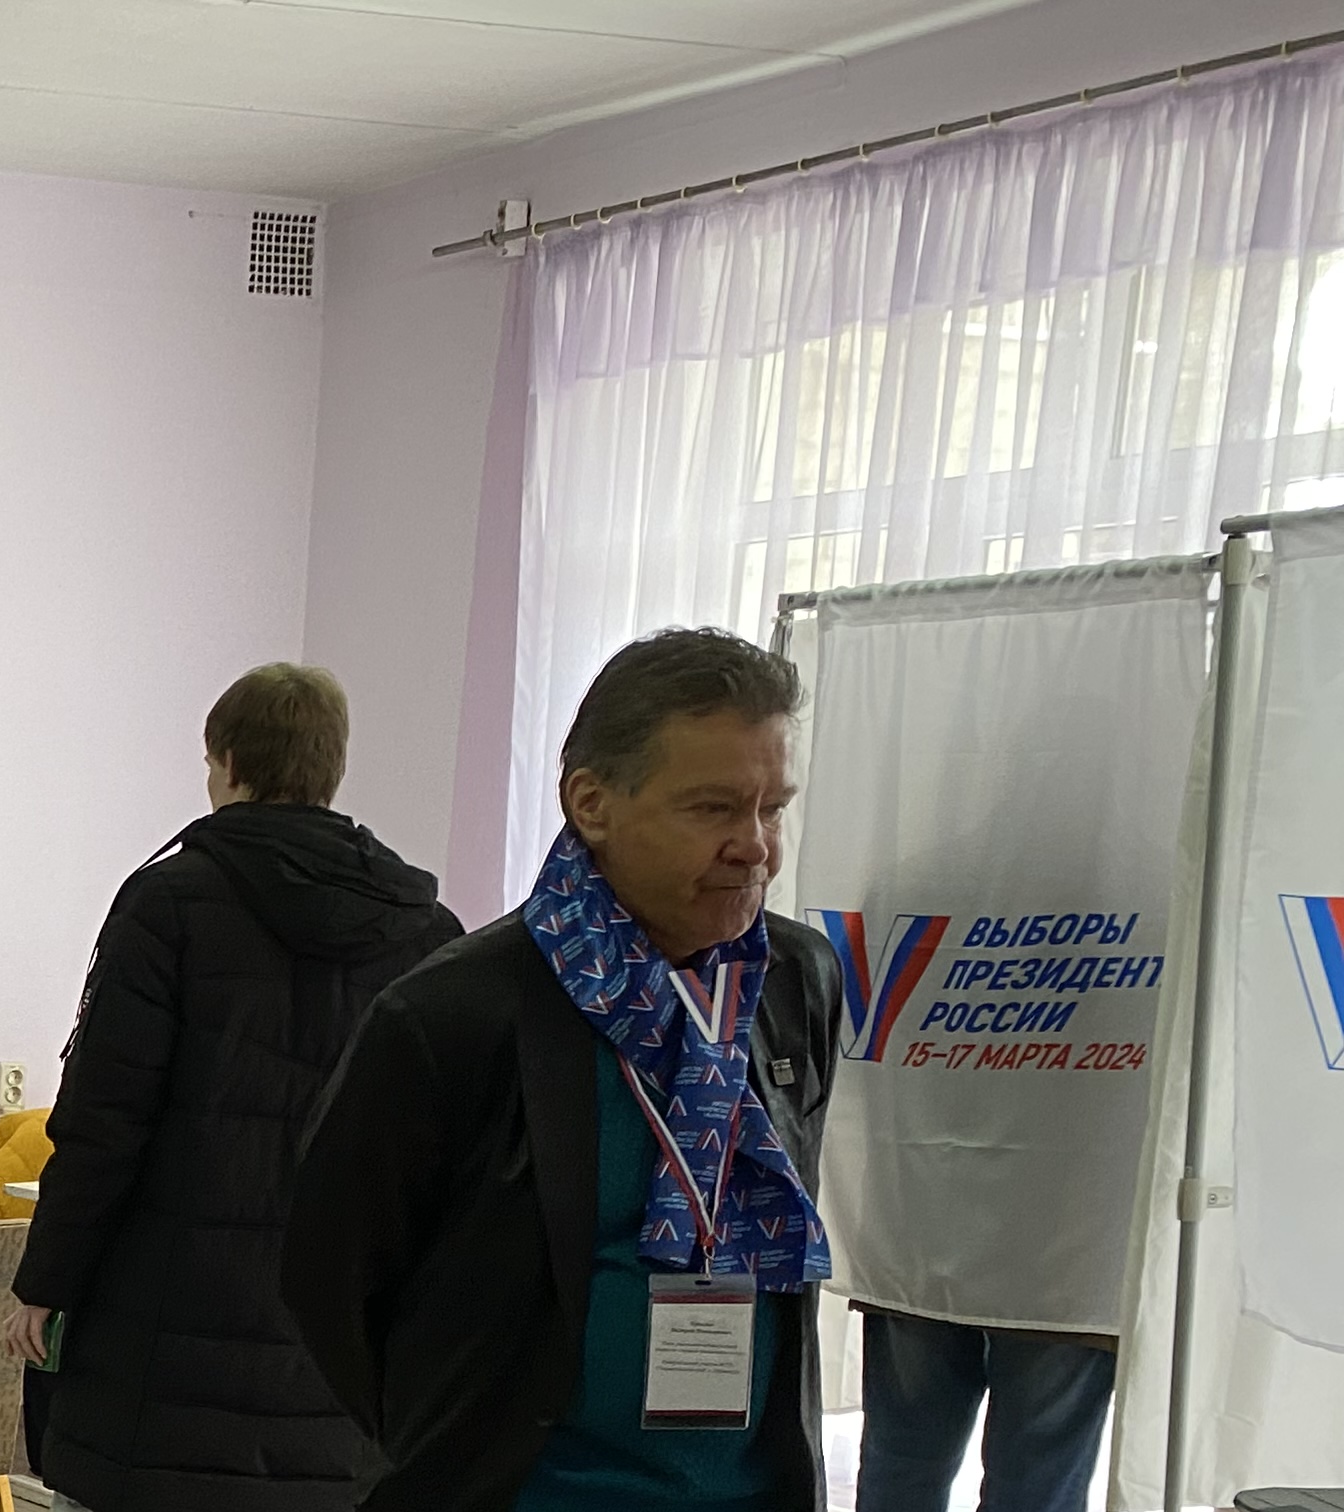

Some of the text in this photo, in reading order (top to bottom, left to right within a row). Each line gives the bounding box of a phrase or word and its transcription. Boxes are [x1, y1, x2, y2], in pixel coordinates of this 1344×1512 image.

[962, 912, 1140, 948] ВЫБОРЫ
[942, 955, 1165, 993] ПРЕЗИДЕНТ
[919, 1002, 1078, 1033] РОССИИ
[973, 1043, 1072, 1071] МАРТА
[1074, 1043, 1148, 1071] 2024
